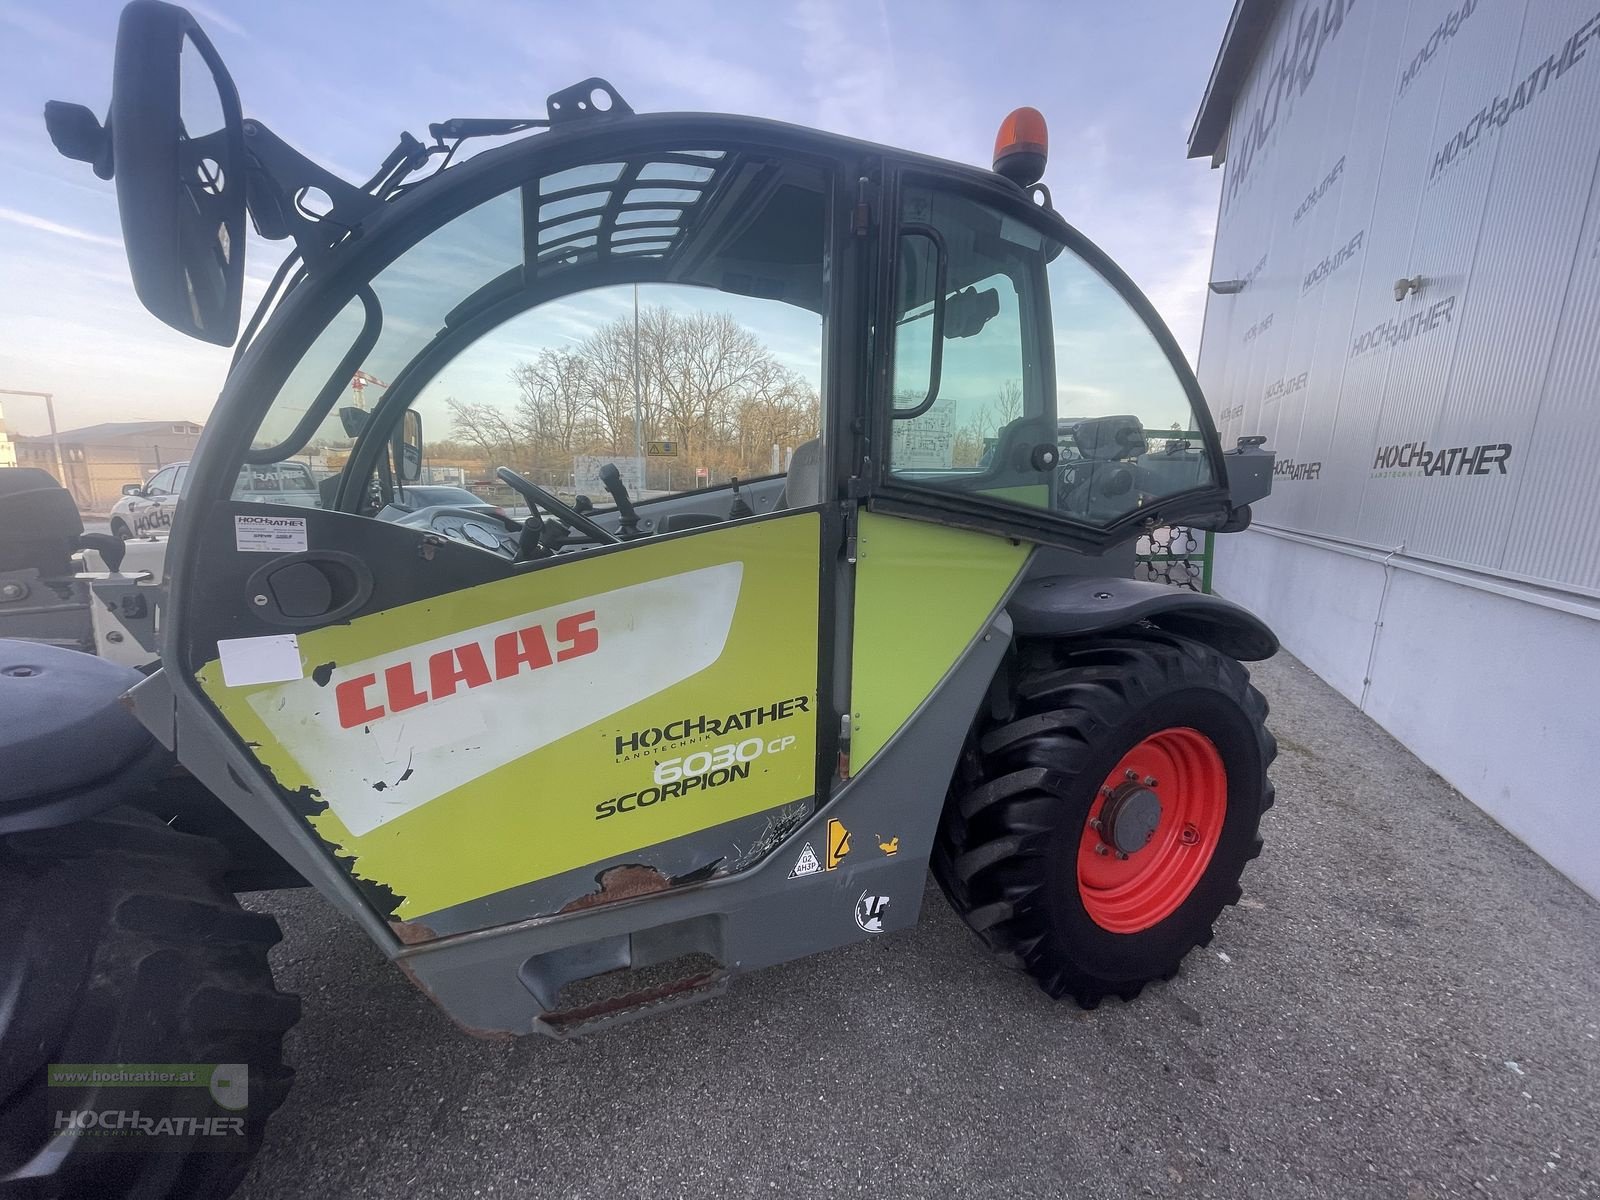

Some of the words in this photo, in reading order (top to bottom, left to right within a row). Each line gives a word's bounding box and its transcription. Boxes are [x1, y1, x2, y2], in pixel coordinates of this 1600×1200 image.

[1351, 295, 1456, 358] HOCHRATHER
[1372, 441, 1513, 477] HOCHRATHER
[133, 509, 175, 536] HOCHR
[238, 516, 304, 527] HOCHRATHER
[335, 610, 599, 729] CLAAS
[615, 695, 810, 756] HOCHRATHER
[615, 734, 711, 764] LANDTECHNIK
[653, 737, 764, 786] 6030
[766, 735, 796, 755] CP
[595, 761, 751, 821] SCORPION
